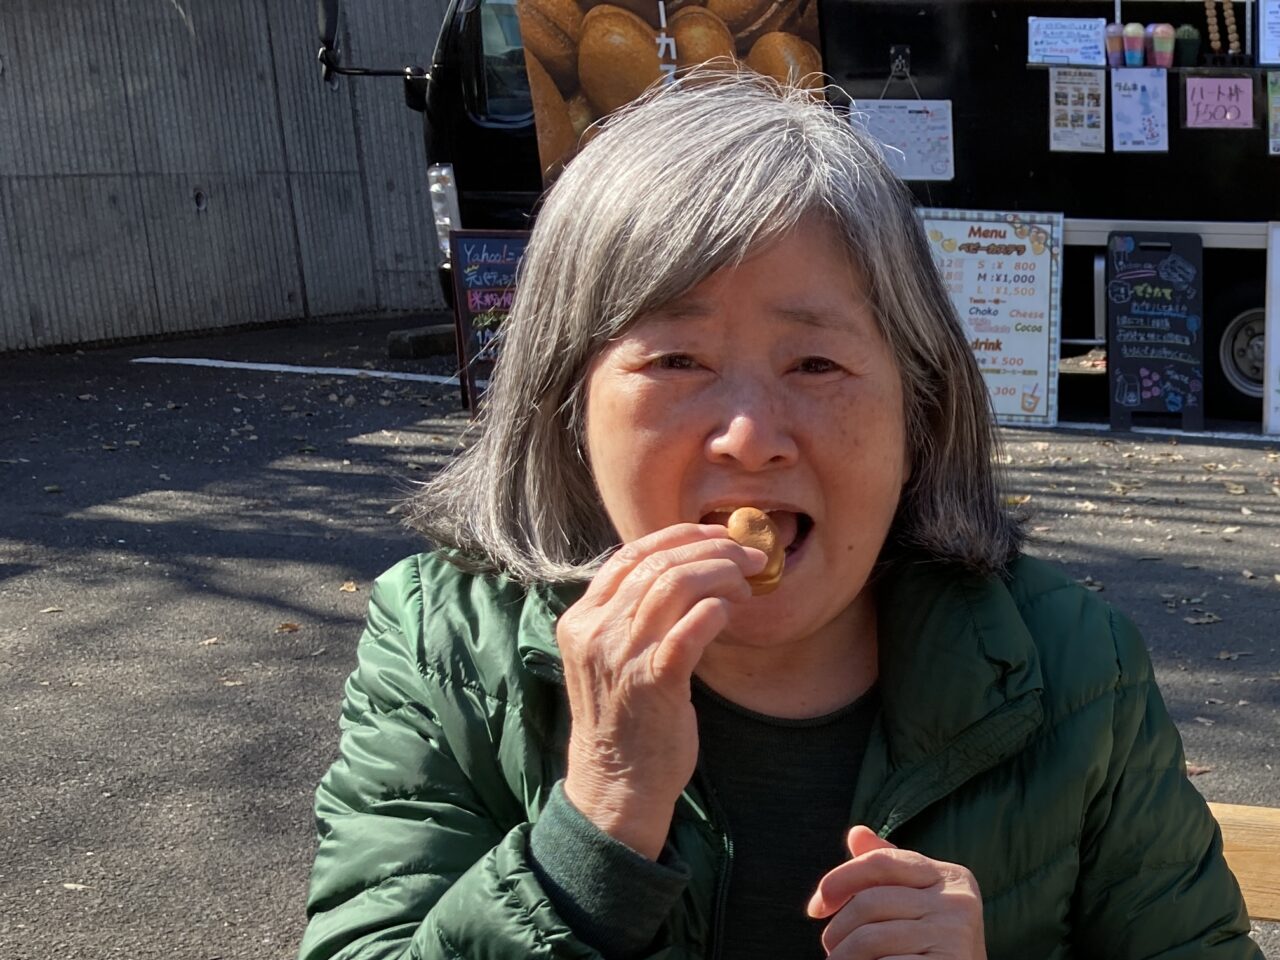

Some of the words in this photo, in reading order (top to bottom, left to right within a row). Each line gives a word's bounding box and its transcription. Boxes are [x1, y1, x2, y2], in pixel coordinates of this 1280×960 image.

[968, 226, 1007, 239] Menu
[1013, 261, 1036, 272] 800
[977, 273, 987, 282] M
[969, 306, 999, 317] Choko
[1009, 308, 1045, 319] Cheese
[1014, 322, 1042, 333] Cocoa
[971, 338, 1002, 352] drink
[1002, 357, 1024, 366] 500
